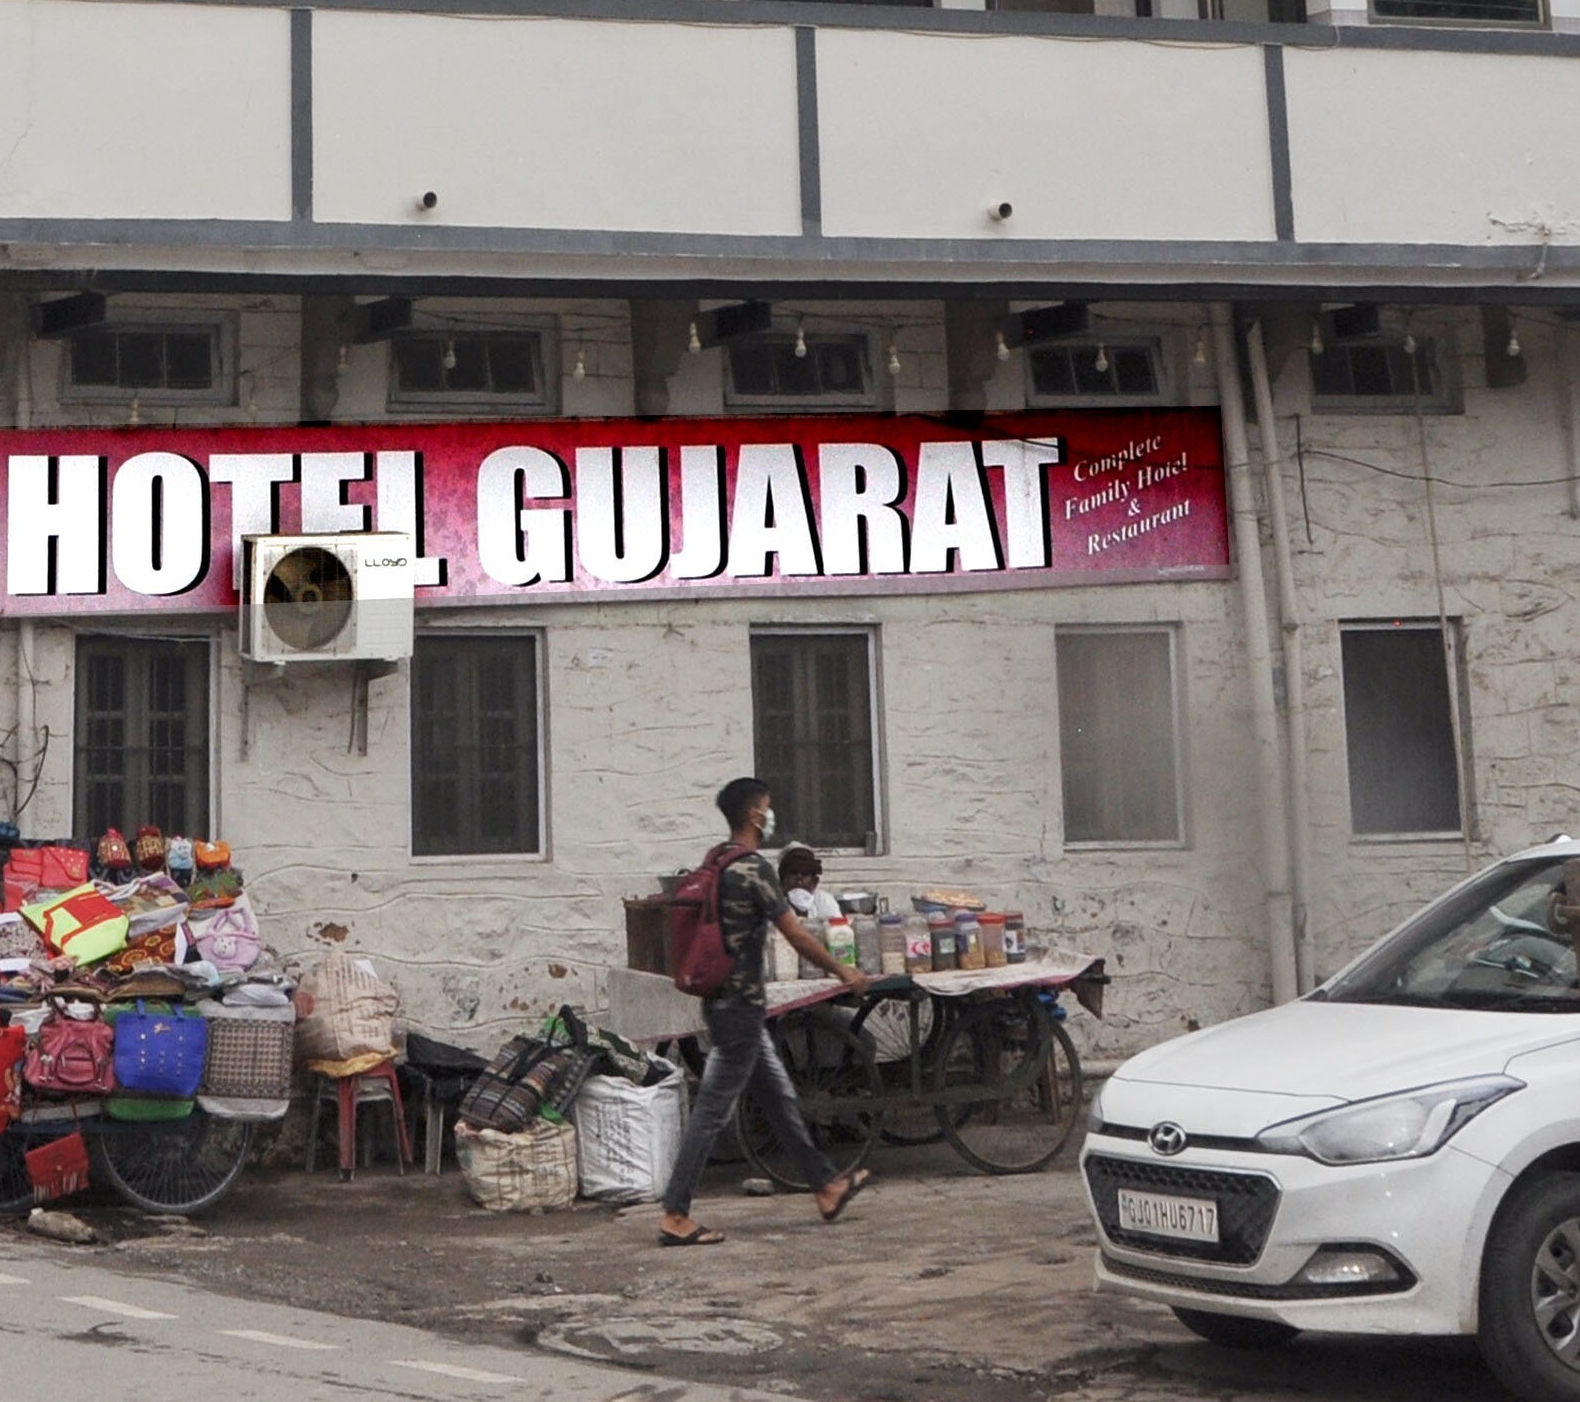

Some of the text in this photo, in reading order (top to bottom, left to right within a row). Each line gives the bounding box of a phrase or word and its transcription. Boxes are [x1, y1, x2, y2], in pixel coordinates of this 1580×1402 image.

[1065, 451, 1188, 520] Family Hotel
[1073, 435, 1162, 482] Complete
[7, 436, 1065, 597] HOTEL GUJARAT
[1088, 499, 1190, 555] Restaurant
[1127, 498, 1141, 516] &
